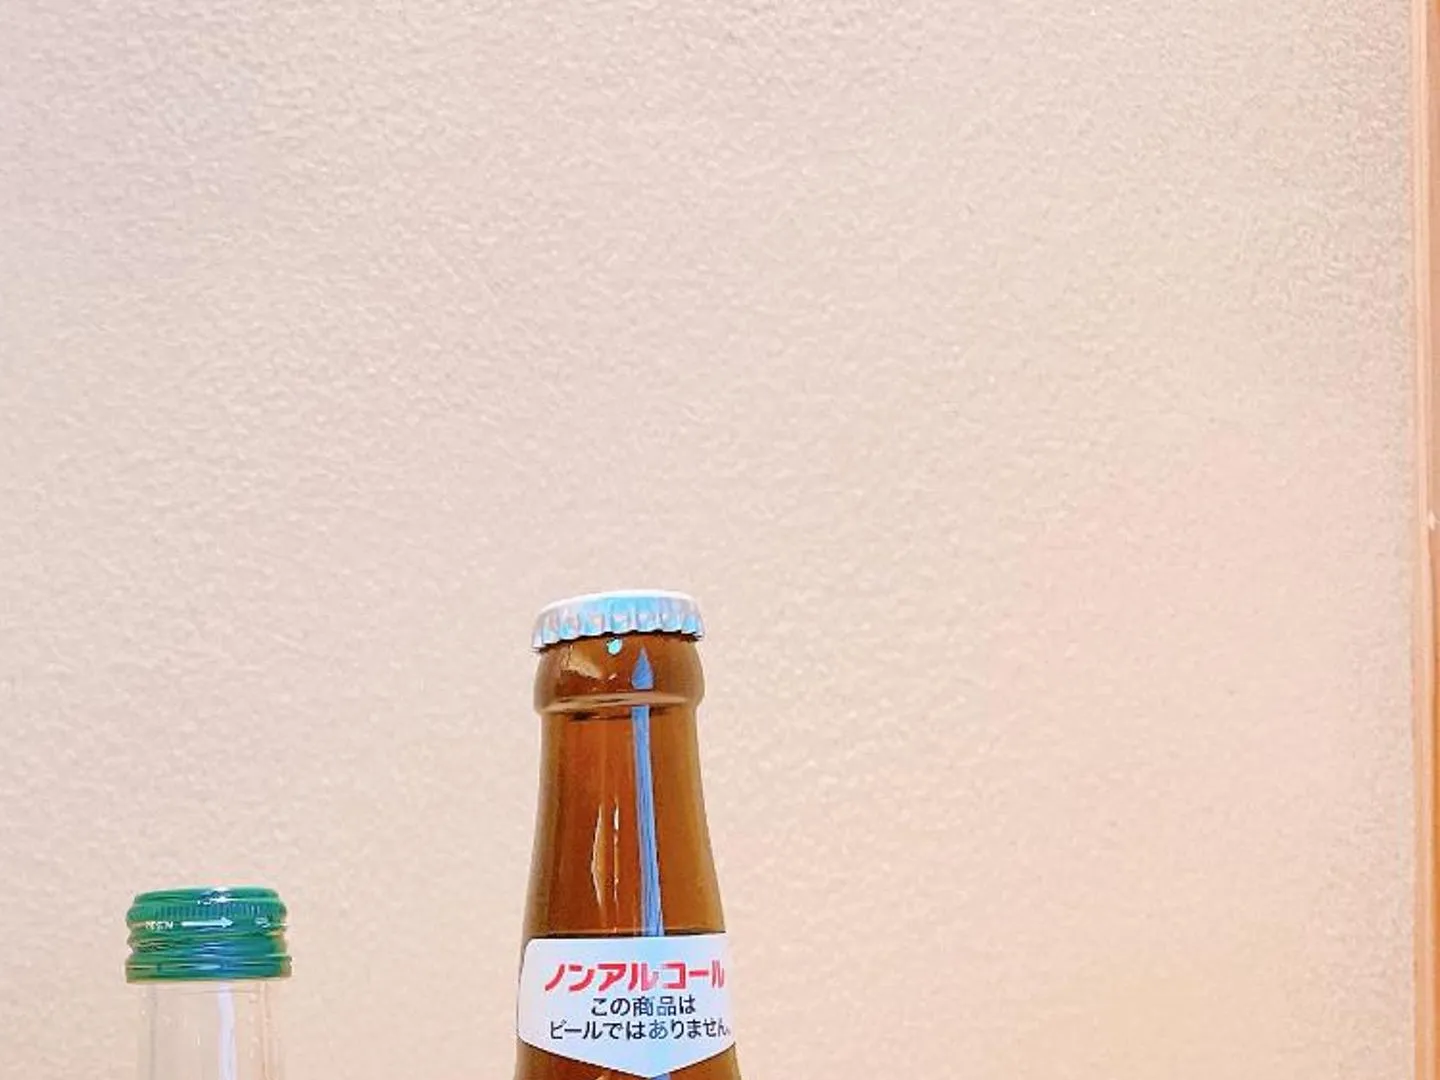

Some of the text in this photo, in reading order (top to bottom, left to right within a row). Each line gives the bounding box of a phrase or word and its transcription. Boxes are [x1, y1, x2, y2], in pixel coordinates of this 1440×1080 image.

[545, 959, 725, 992] ノンアルコール
[591, 996, 696, 1017] この商品は
